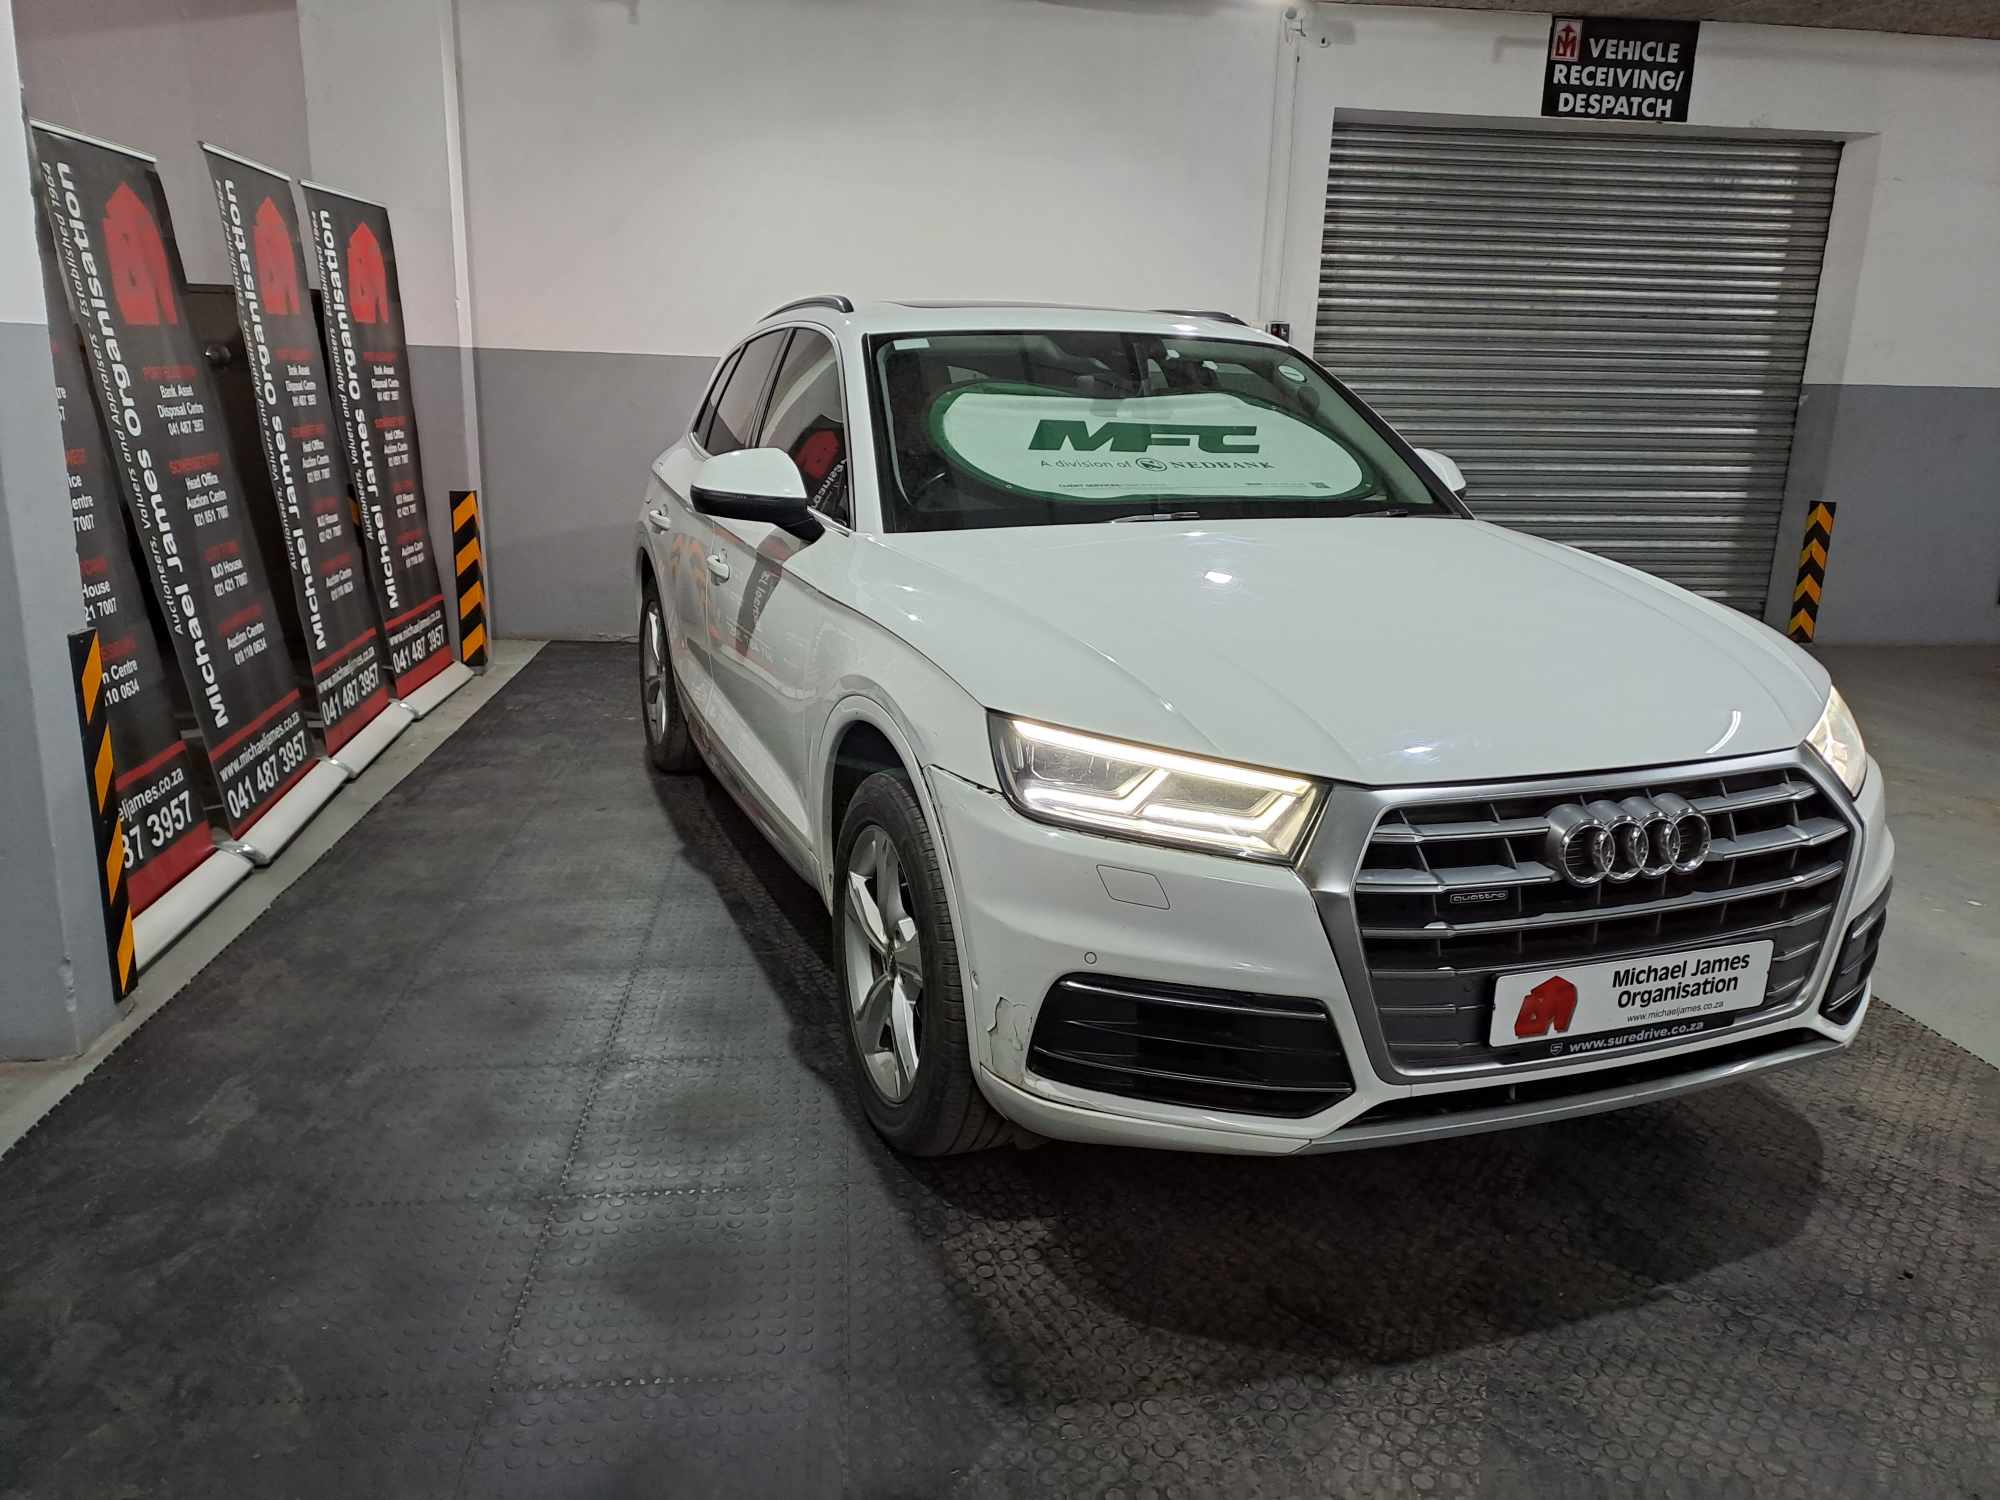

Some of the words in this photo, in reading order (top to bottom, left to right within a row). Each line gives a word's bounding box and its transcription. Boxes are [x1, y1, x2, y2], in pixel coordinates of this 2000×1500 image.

[1552, 63, 1685, 92] RECEIVING/
[1588, 38, 1681, 63] VEHICLE
[1558, 92, 1673, 118] DESPATCH
[54, 212, 91, 317] Established
[57, 162, 142, 437] Organisation
[225, 180, 276, 405] Organisation
[320, 210, 360, 400] Organisation
[88, 332, 122, 426] Appraisers
[114, 429, 132, 463] and
[355, 408, 379, 497] James
[1028, 419, 1260, 454] MFC
[1055, 458, 1115, 469] division
[1116, 457, 1131, 468] of
[1170, 460, 1275, 469] NEDBANK
[272, 416, 300, 519] James
[72, 493, 94, 510] entre
[128, 466, 152, 529] Valuers
[137, 449, 183, 573] James
[371, 505, 399, 609] Michael
[84, 604, 96, 621] 21
[97, 596, 118, 617] 7007
[150, 535, 184, 635] Auctioneers,
[292, 528, 327, 650] Michael
[111, 658, 138, 681] Centre
[174, 584, 230, 729] Michael
[392, 647, 412, 674] 041
[411, 638, 426, 662] 487
[427, 624, 445, 651] 3957
[121, 677, 140, 700] 0634
[321, 691, 342, 726] 041
[342, 677, 360, 709] 487
[360, 662, 380, 696] 3957
[118, 767, 185, 822] eljames.co.za
[227, 775, 256, 819] 041
[256, 754, 280, 793] 487
[279, 729, 308, 773] 3957
[146, 789, 192, 847] 3957
[1452, 891, 1506, 903] quattro
[1612, 960, 1687, 988] Michael
[1690, 953, 1750, 976] James
[1617, 975, 1738, 1009] Organisation
[1569, 1021, 1704, 1052] www.suredrive.co.za
[1626, 1000, 1724, 1023] www.michaeljames.co.za
